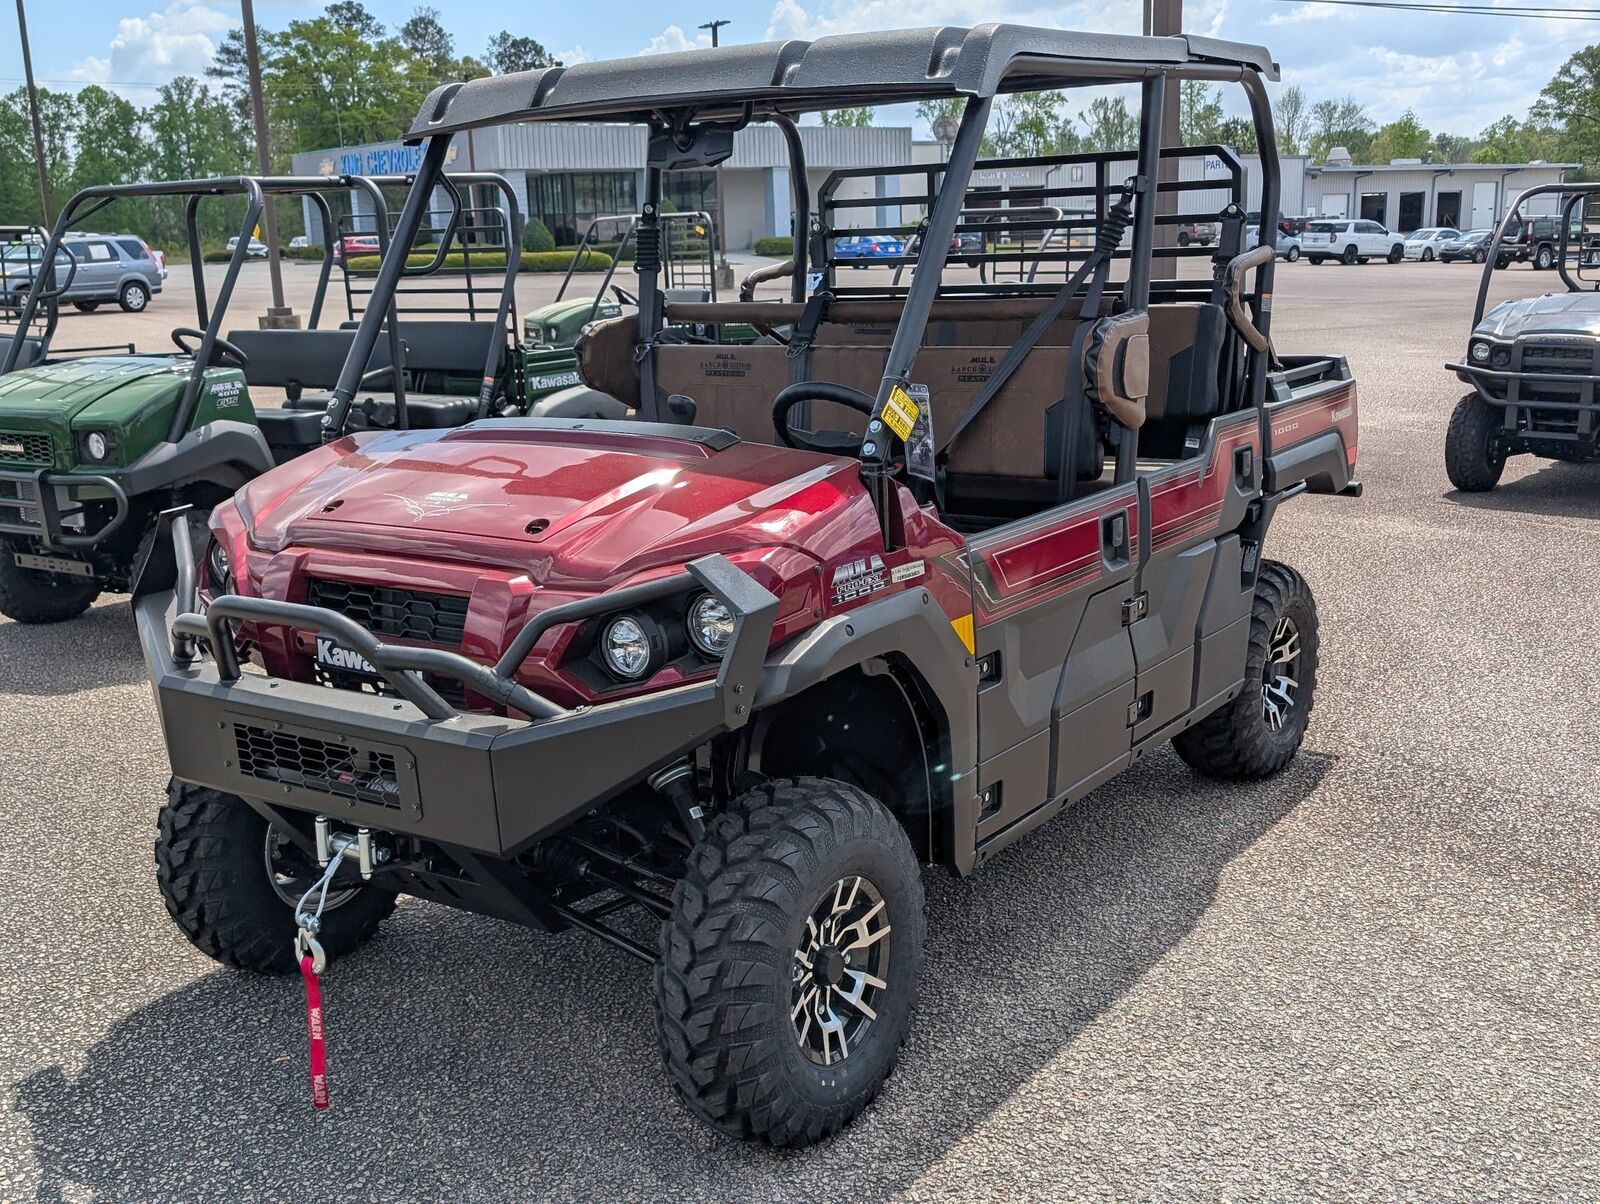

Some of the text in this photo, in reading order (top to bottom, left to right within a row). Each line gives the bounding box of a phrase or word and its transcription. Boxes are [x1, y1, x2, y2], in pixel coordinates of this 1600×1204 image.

[340, 153, 362, 176] KING
[1206, 160, 1228, 170] PART
[970, 356, 997, 364] MULE
[531, 371, 582, 390] Kawasak
[1274, 422, 1299, 435] 1000
[310, 1007, 323, 1040] WARN
[313, 1074, 327, 1104] WARN
